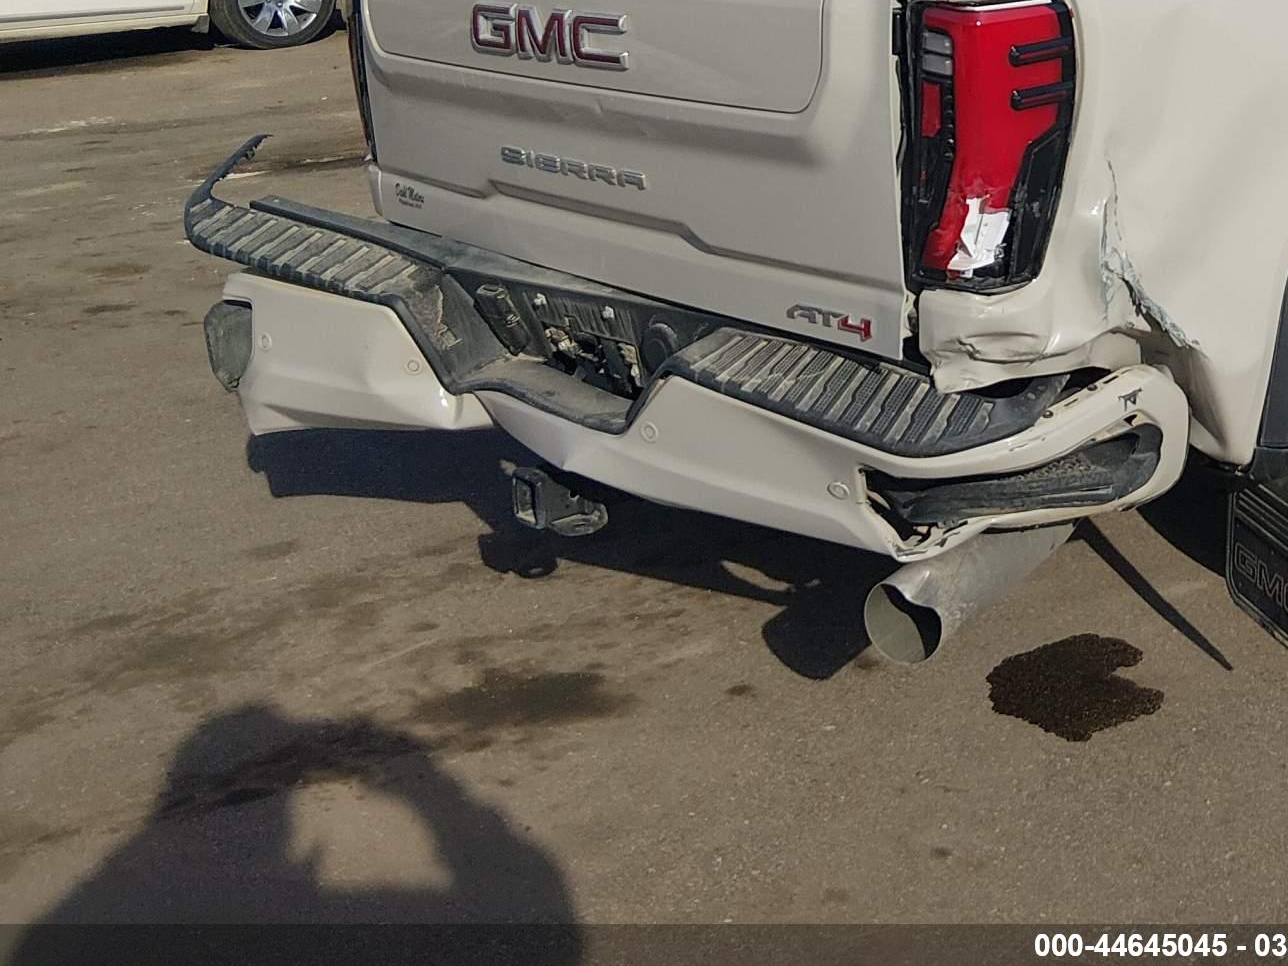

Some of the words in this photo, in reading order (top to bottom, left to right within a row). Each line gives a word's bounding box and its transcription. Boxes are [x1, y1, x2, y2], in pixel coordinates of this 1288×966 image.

[470, 0, 629, 71] GMC
[501, 145, 646, 190] SIERRA
[786, 302, 873, 342] AT4
